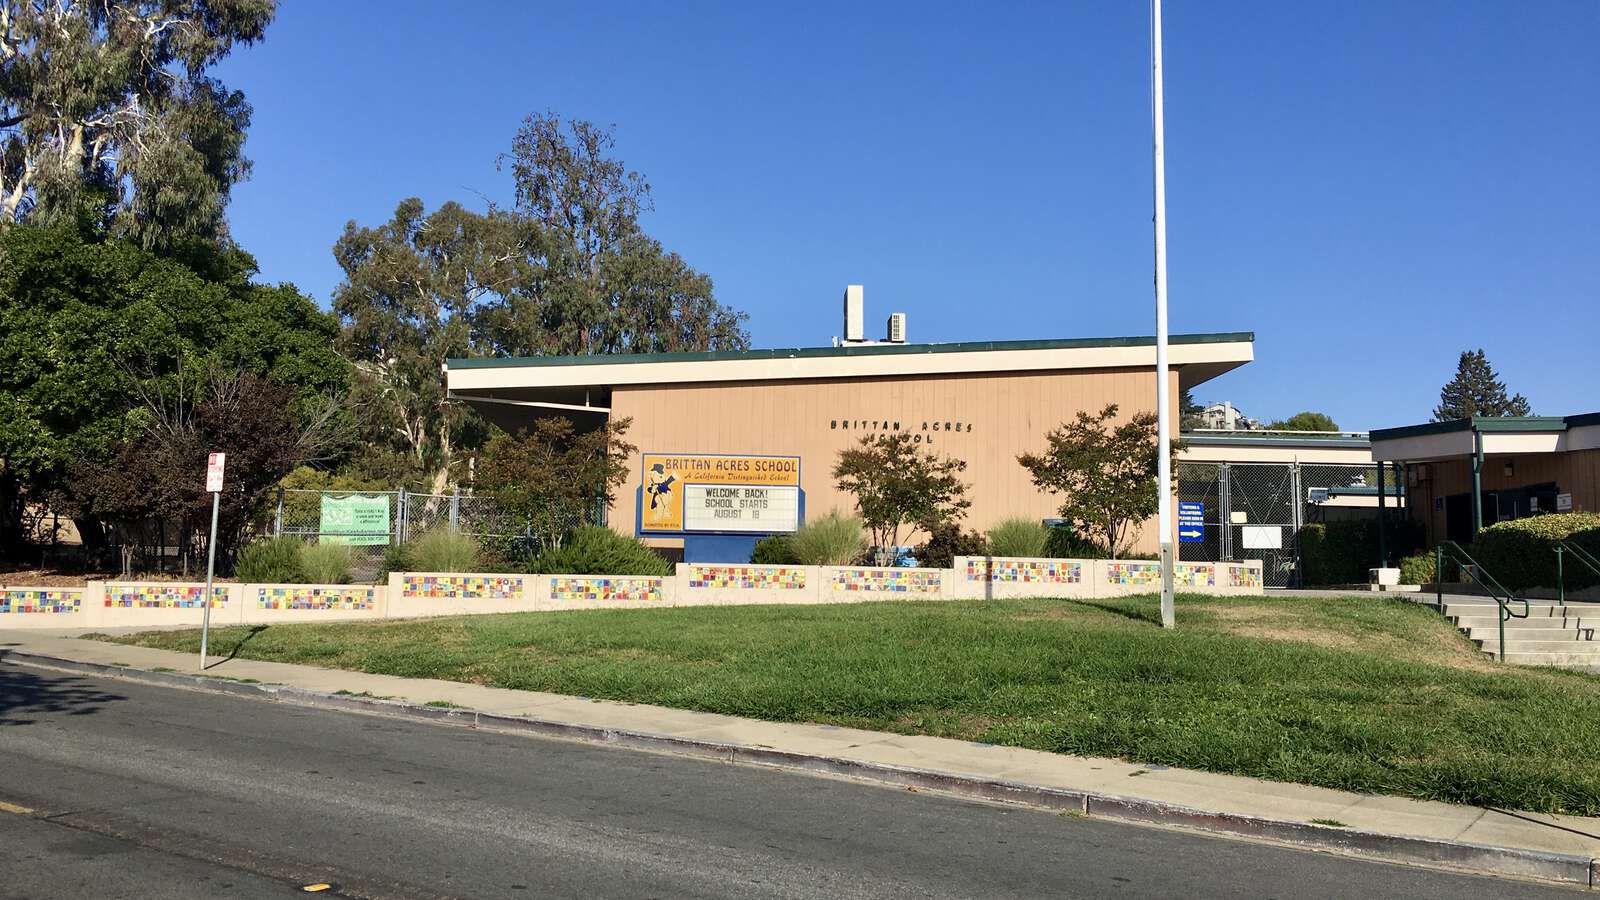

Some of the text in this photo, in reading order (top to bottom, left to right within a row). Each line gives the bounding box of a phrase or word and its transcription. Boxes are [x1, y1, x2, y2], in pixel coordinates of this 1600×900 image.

[830, 420, 972, 433] BRITTAN ACRES
[665, 458, 797, 472] BRITTAN ACRES SCHOOL
[694, 472, 725, 480] California
[728, 473, 767, 481] Distinguished
[705, 488, 768, 498] WELCOME BACK!
[705, 498, 768, 509] SCHOOL STARTS
[714, 509, 742, 519] AUGUST
